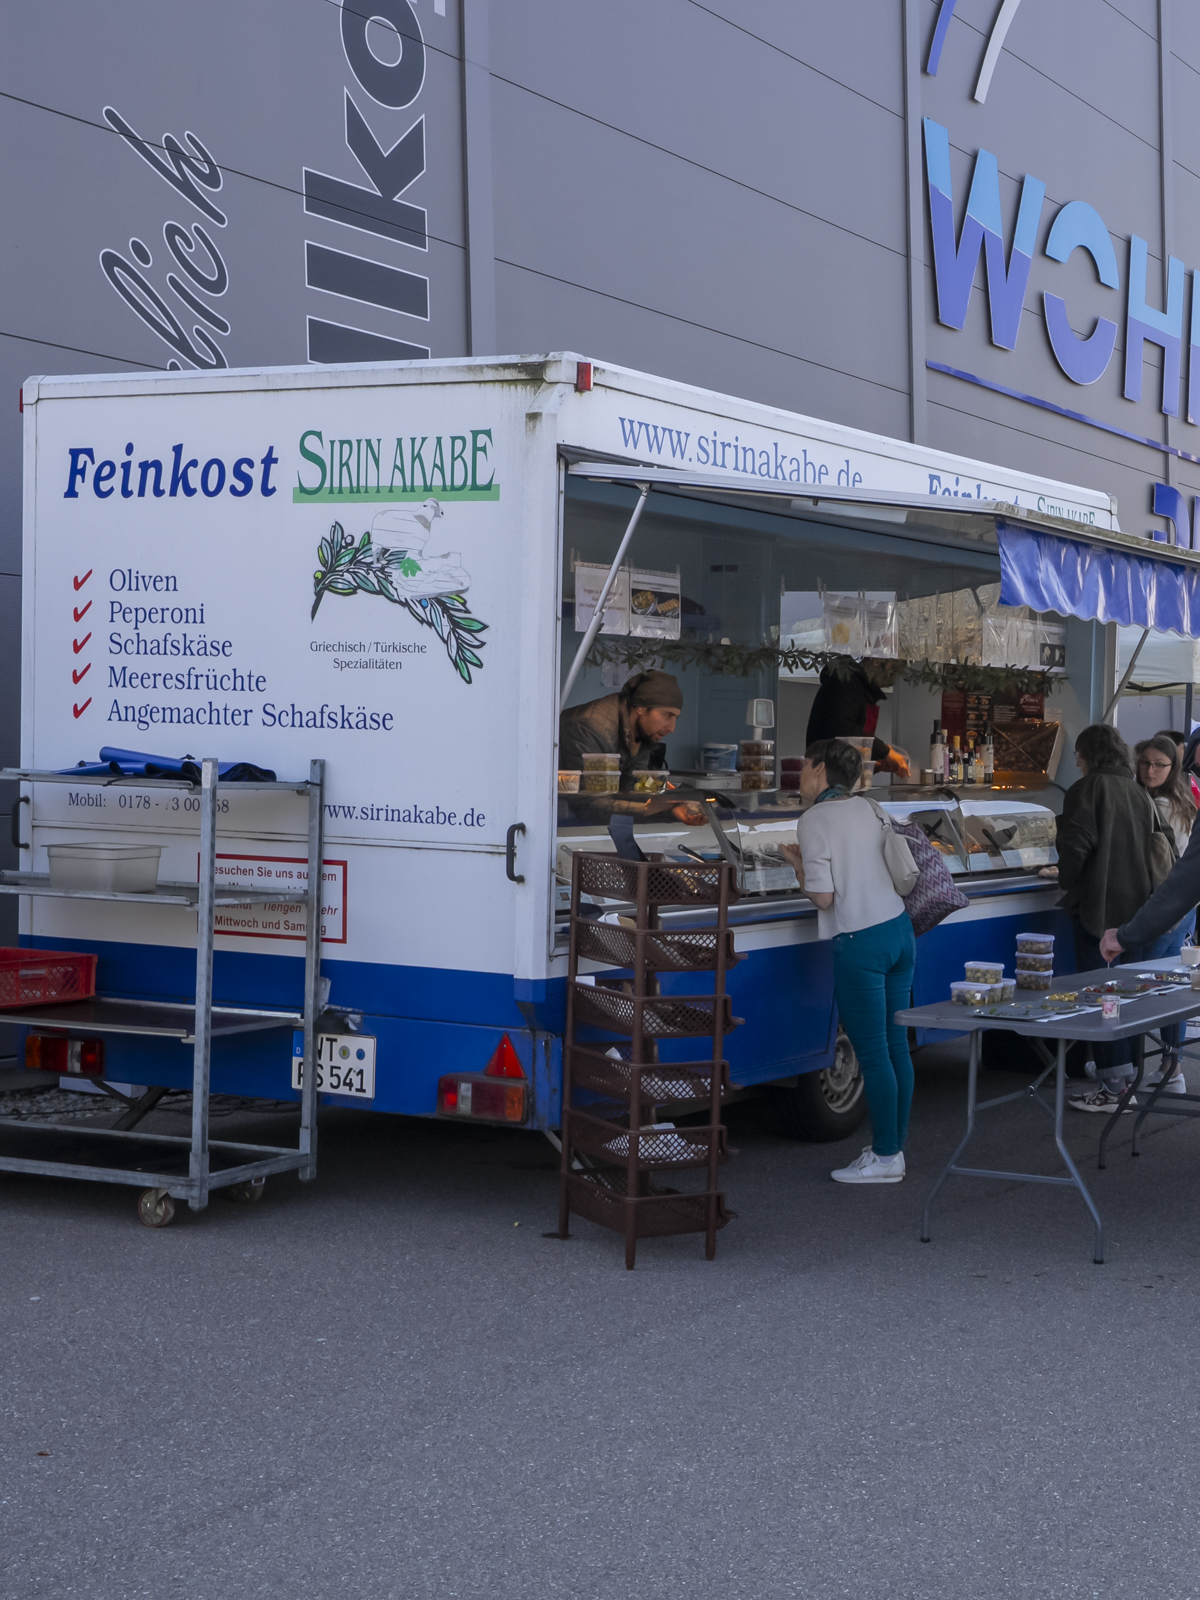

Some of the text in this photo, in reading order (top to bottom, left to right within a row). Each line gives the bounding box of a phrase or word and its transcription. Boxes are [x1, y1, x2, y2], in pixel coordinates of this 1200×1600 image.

[100, 106, 230, 370] lich
[618, 417, 862, 488] www.sirinakabede
[63, 442, 279, 499] Feinkost
[109, 569, 179, 592] Oliven
[108, 600, 206, 631] Peperoni
[108, 632, 233, 657] Schafskäse
[310, 641, 366, 653] Griechisch
[373, 641, 427, 654] Türkische
[333, 658, 403, 671] Spezialitäten
[107, 665, 267, 693] Meeresfrüchte
[107, 699, 394, 731] Angemachter Schafskäse
[68, 793, 106, 807] Mobil:
[119, 795, 151, 809] 0178
[214, 865, 337, 882] esuchen Sie uns au em
[263, 902, 302, 915] Tiengen
[215, 915, 259, 928] Mittwoch
[262, 919, 281, 930] und
[329, 1065, 367, 1094] 541
